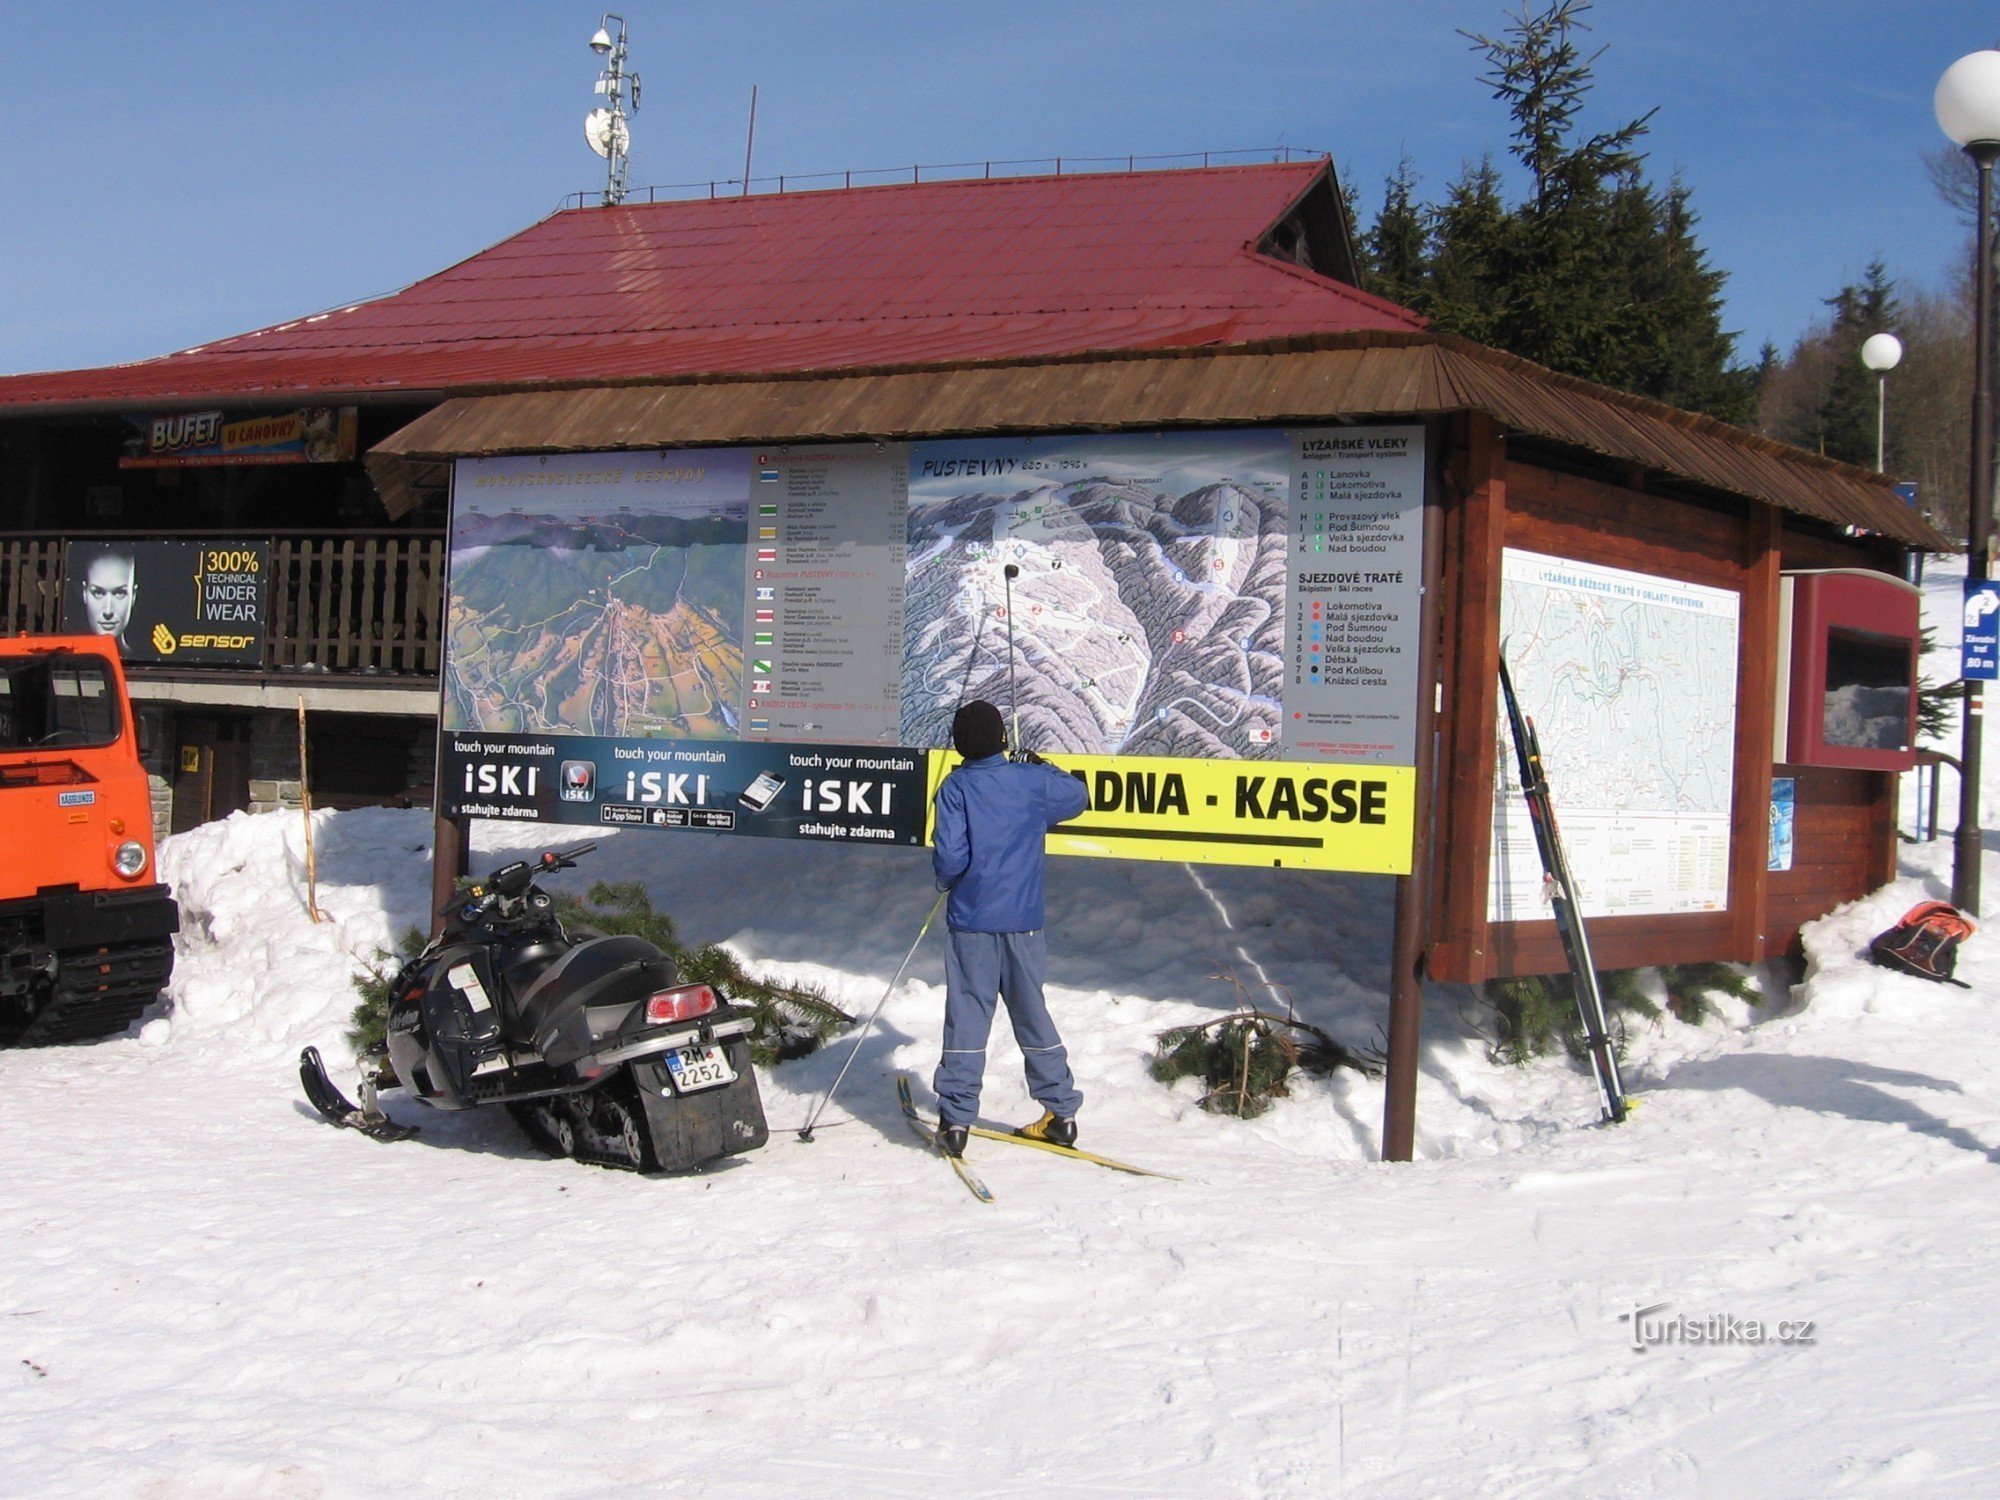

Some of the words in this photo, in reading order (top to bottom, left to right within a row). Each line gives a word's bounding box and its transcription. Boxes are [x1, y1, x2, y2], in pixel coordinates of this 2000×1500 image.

[152, 412, 220, 449] BUFET
[227, 429, 236, 444] U
[1302, 438, 1364, 452] LYŽAŘSKÉ
[1368, 438, 1408, 449] VLEKY
[922, 459, 1018, 477] PUSTEVNY
[1330, 471, 1370, 479] Lanovka
[1330, 481, 1385, 489] Lokomotiva
[1301, 492, 1308, 500] C
[1330, 491, 1351, 499] Malá
[1354, 491, 1402, 501] sjezdovka
[1301, 513, 1307, 521] H
[1329, 512, 1379, 522] Provazový
[1381, 512, 1401, 520] vlek
[1300, 523, 1303, 531] I
[1329, 523, 1347, 531] Pod
[1350, 521, 1390, 531] Šumnou
[1299, 534, 1305, 542] J
[1328, 533, 1353, 542] Velká
[1356, 533, 1404, 543] sjezdovka
[1328, 544, 1347, 552] Nad
[1349, 544, 1386, 552] boudou
[207, 551, 259, 572] 300%
[206, 573, 257, 583] TECHNICAL
[1298, 571, 1360, 583] SJEZDOVÉ
[1364, 571, 1403, 583] TRATĚ
[205, 586, 257, 600] UNDER
[1298, 602, 1303, 610] 1
[1327, 602, 1382, 610] Lokomotiva
[206, 603, 257, 621] WEAR
[1297, 613, 1303, 621] 2
[1326, 613, 1348, 621] Malá
[1351, 613, 1398, 623] sjezdovka
[1297, 623, 1303, 631] 3
[1326, 623, 1344, 632] Pod
[1347, 622, 1387, 632] Šumnou
[179, 635, 255, 648] sensor
[1297, 634, 1302, 642] 4
[1325, 634, 1344, 642] Nad
[1347, 634, 1383, 642] boudou
[1297, 644, 1302, 652] 5
[1325, 644, 1350, 653] Velká
[1353, 645, 1401, 655] sjezdovka
[1296, 655, 1302, 663] 6
[1325, 655, 1357, 664] Dětská
[1966, 657, 1981, 668] 80
[1983, 660, 1994, 668] m
[1296, 665, 1301, 673] 7
[1324, 666, 1343, 674] Pod
[1346, 666, 1383, 675] Kolibou
[1295, 676, 1301, 684] 8
[1324, 676, 1359, 685] Knížecí
[1361, 677, 1387, 685] cesta
[454, 741, 481, 753] touch
[483, 743, 506, 756] your
[507, 743, 555, 756] mountain
[614, 747, 644, 759] touch
[647, 750, 672, 763] your
[674, 750, 726, 763] mountain
[790, 753, 822, 767] touch
[825, 757, 853, 771] your
[855, 757, 914, 771] mountain
[464, 763, 537, 796] iSKI
[625, 771, 706, 805] iSKI
[565, 789, 590, 800] iSKI
[802, 778, 893, 816] iSKI
[1235, 776, 1388, 825] KASSE
[461, 803, 500, 817] stahujte
[502, 804, 538, 818] zdarma
[612, 812, 625, 821] App
[625, 812, 642, 821] Store
[800, 823, 847, 838] stahujte
[849, 825, 895, 839] zdarma
[678, 1064, 724, 1087] 2252
